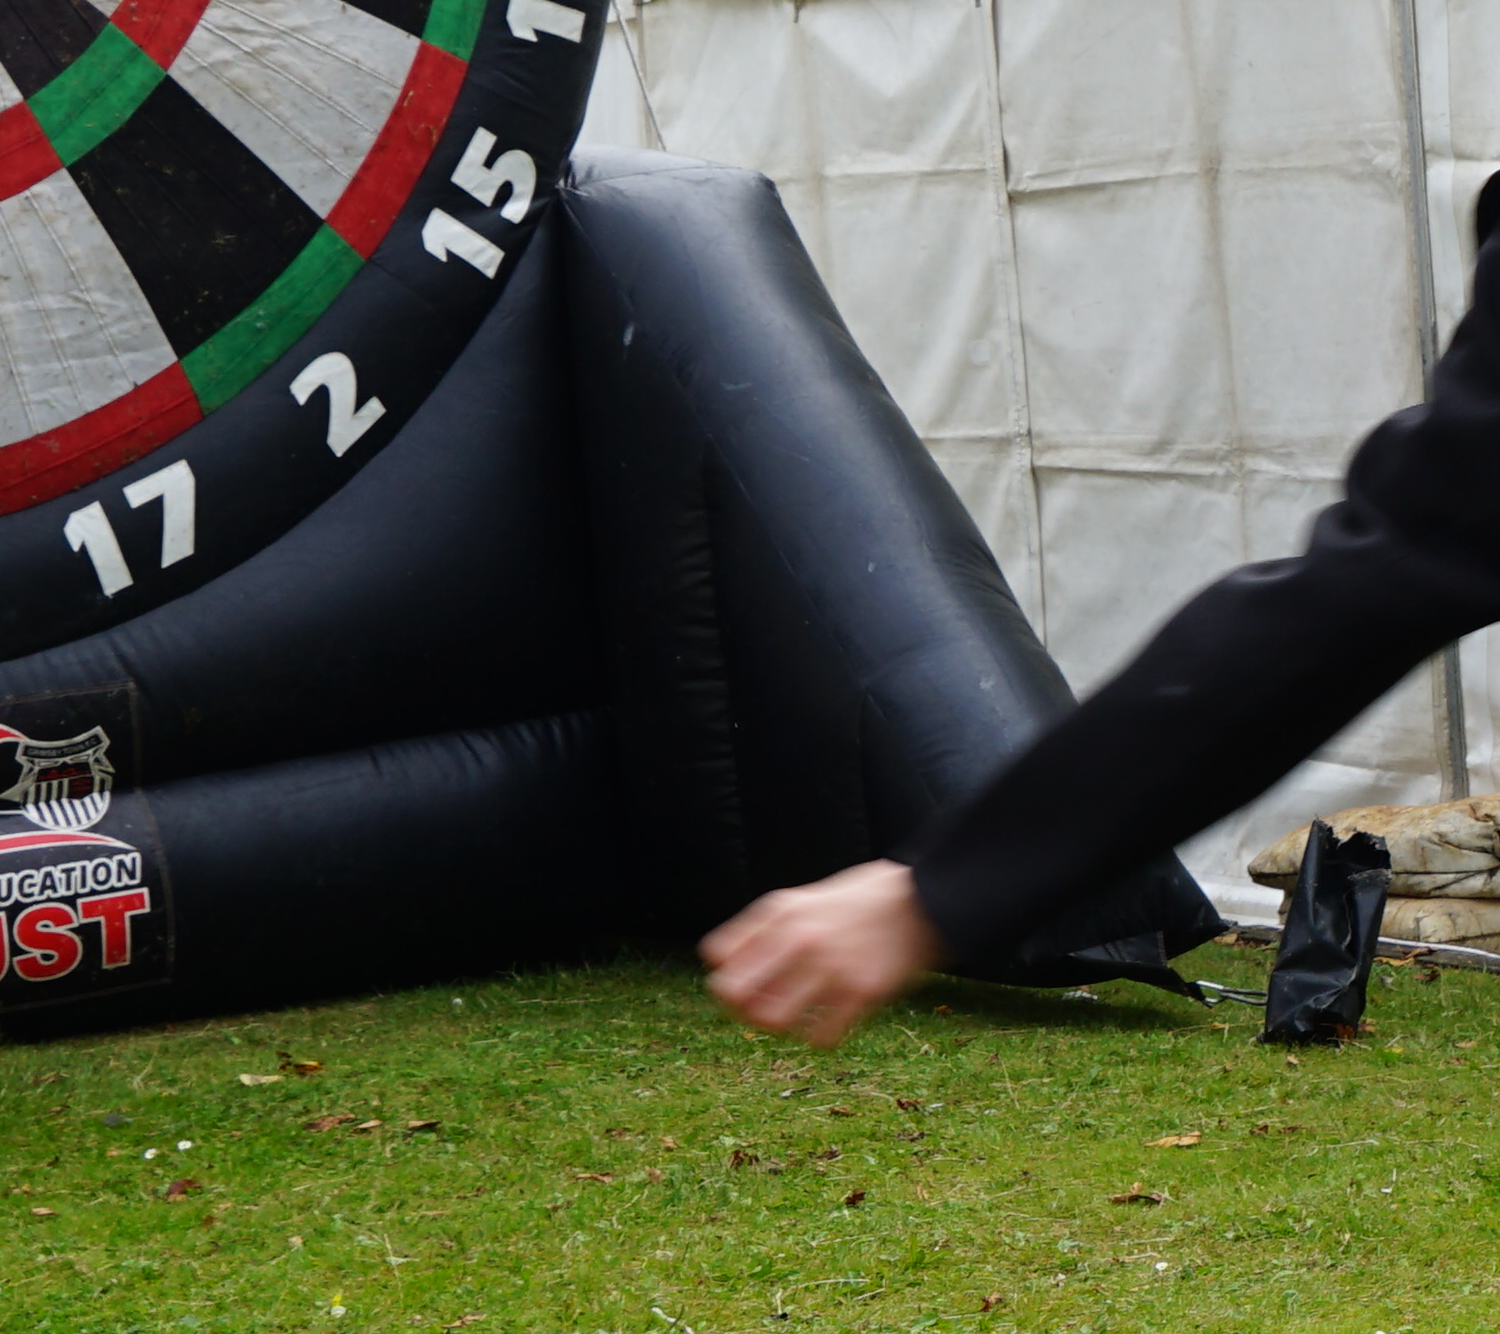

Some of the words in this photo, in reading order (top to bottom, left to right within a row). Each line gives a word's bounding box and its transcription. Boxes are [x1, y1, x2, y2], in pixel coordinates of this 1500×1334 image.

[422, 127, 535, 278] 15
[290, 352, 385, 457] 2
[64, 460, 195, 596] 17
